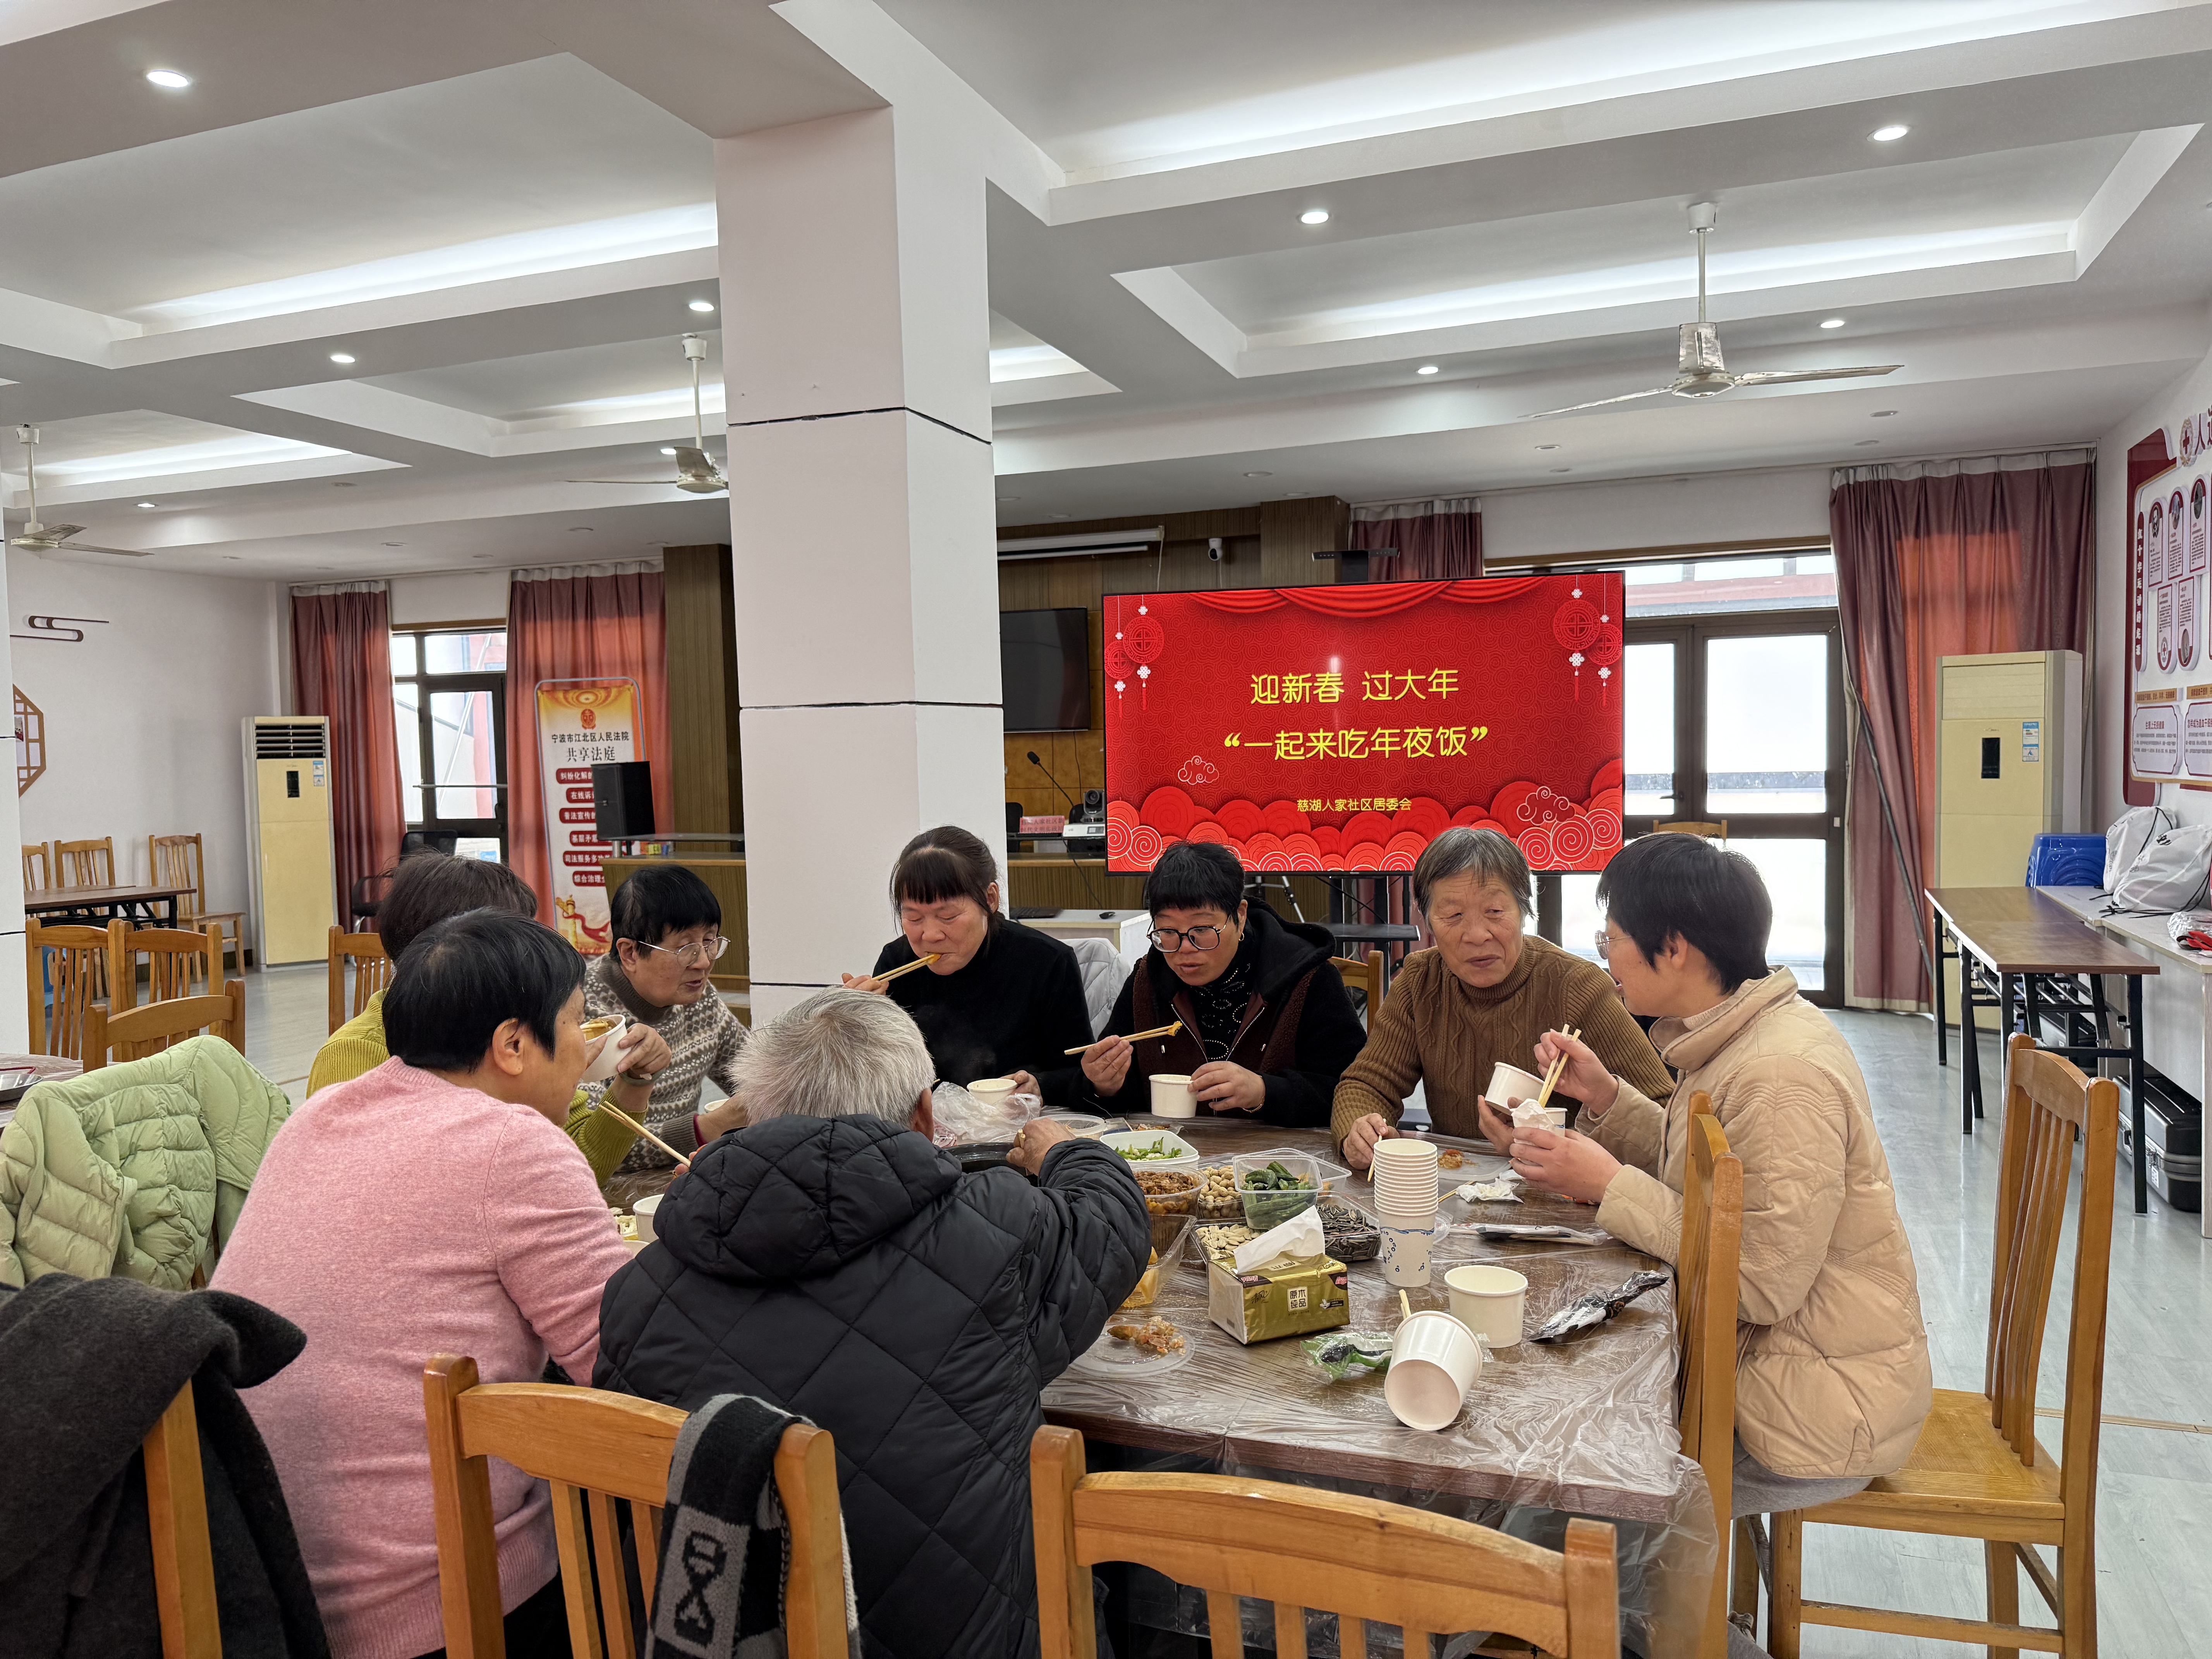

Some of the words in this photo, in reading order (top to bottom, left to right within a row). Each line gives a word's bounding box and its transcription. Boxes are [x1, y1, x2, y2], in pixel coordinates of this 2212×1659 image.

[1250, 672, 1344, 704] 迎新春
[1362, 668, 1459, 701] 过大年
[551, 731, 629, 743] 宁波市江北区人民法院
[1224, 726, 1488, 760] “一起来吃年夜饭”
[567, 746, 616, 762] 共享法庭
[1297, 797, 1412, 812] 慈湖人家社区居委会
[1290, 1289, 1306, 1299] 原木
[1290, 1298, 1307, 1309] 纯品
